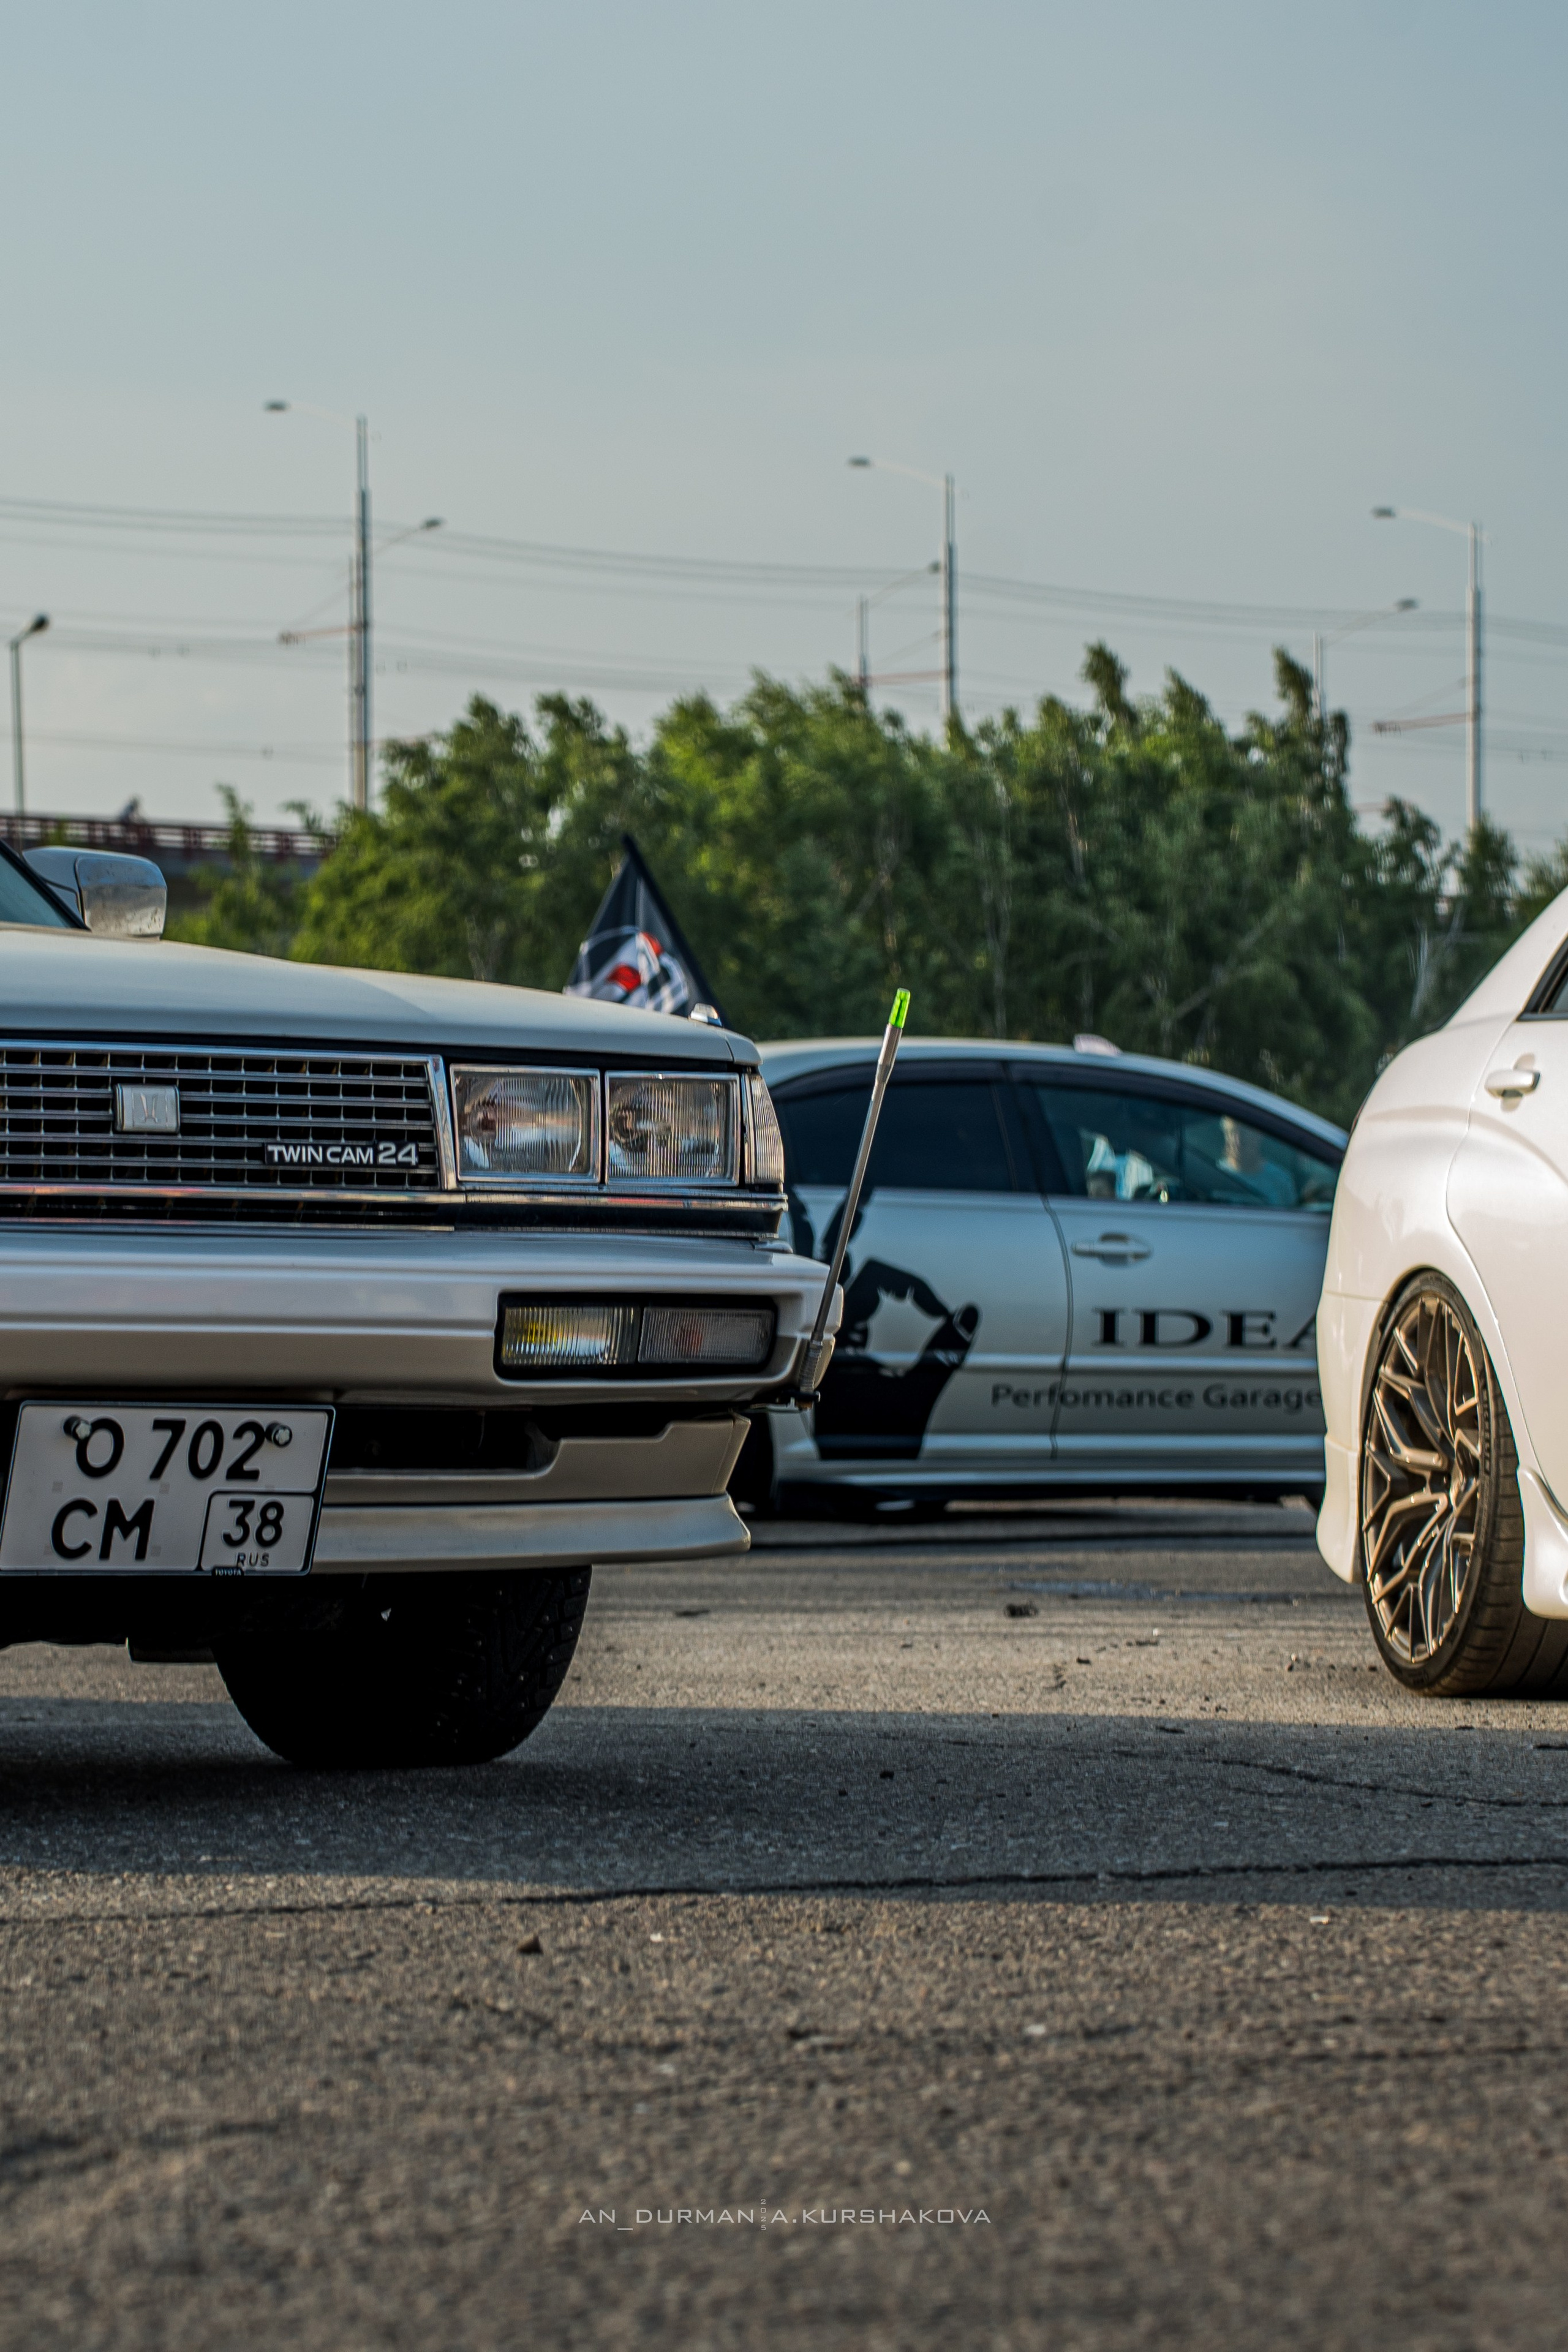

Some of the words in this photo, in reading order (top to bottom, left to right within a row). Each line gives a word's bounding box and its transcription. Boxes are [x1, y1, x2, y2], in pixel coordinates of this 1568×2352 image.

[379, 1141, 418, 1166] 24
[1203, 1382, 1321, 1414] Garage
[149, 1418, 265, 1481] 702
[222, 1499, 284, 1548] 38
[214, 1567, 242, 1577] TOYOTA
[236, 1553, 270, 1567] RUS
